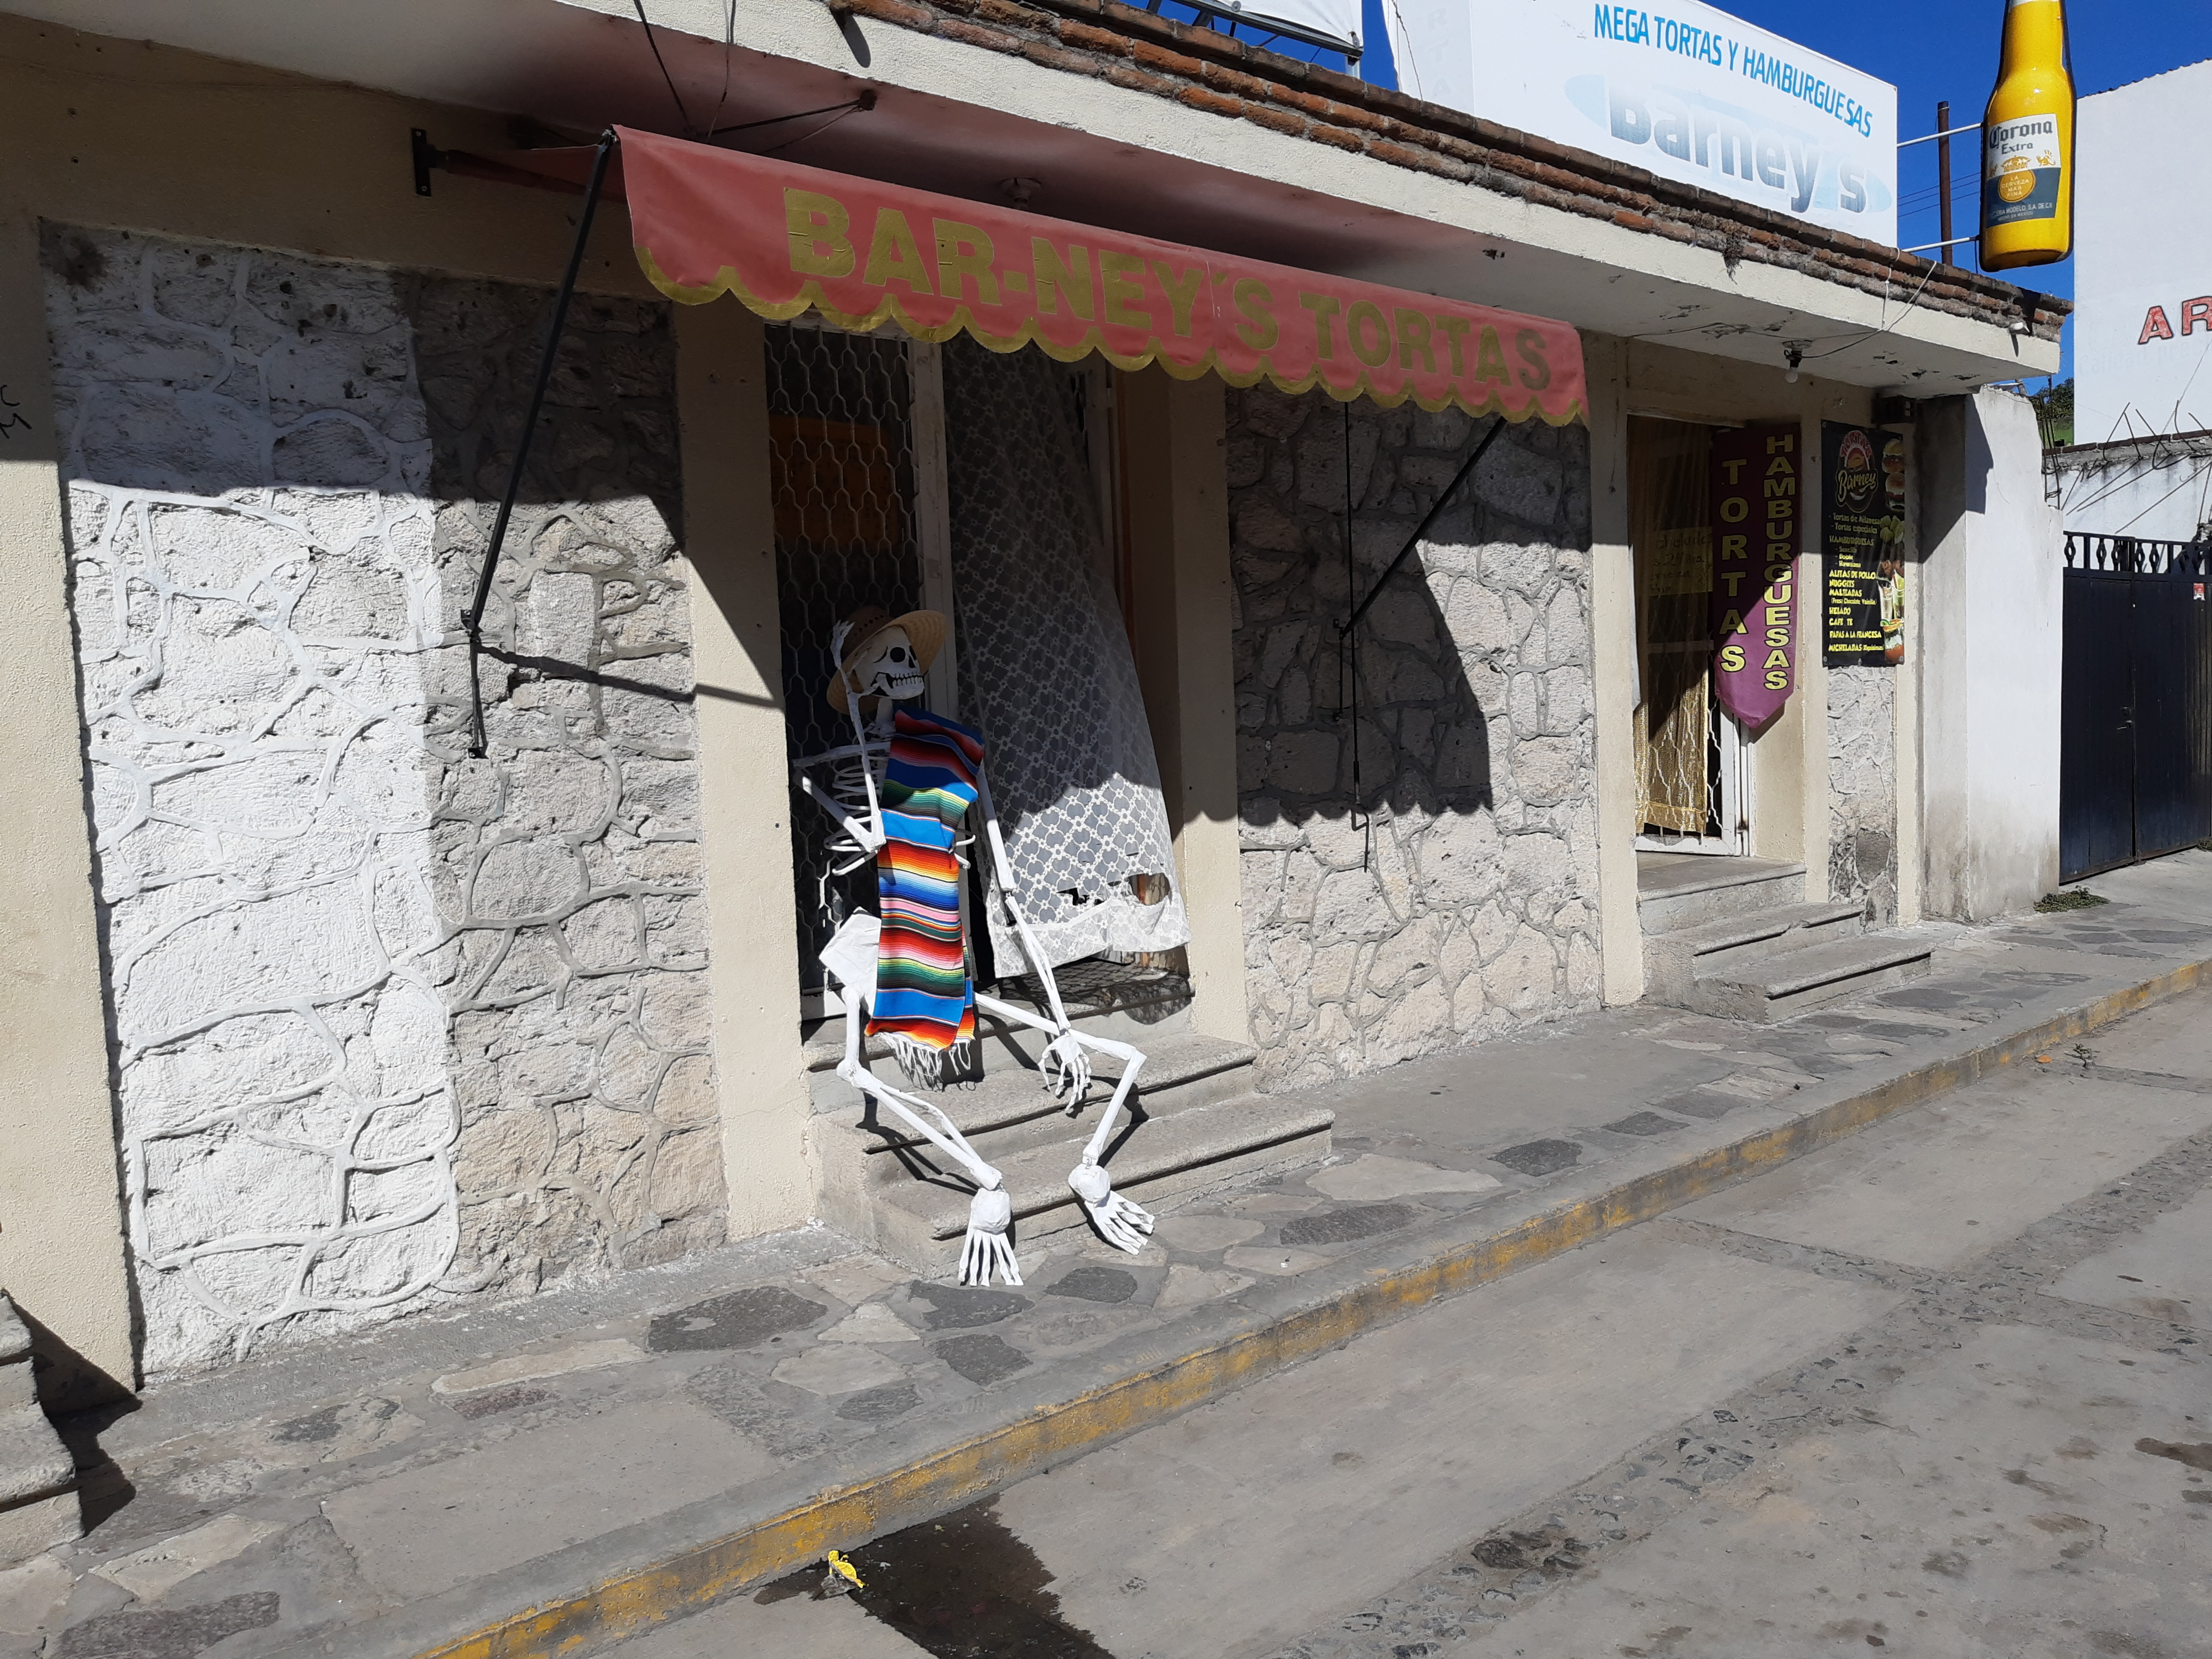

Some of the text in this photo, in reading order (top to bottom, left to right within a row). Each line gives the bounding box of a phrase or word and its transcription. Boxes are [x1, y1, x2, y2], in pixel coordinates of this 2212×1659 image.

[1594, 3, 1873, 138] MEGA TORTAS Y HAMBURGUESAS
[1989, 121, 2053, 149] Corona
[2001, 142, 2033, 155] Extra
[2006, 205, 2026, 213] MODELO
[783, 187, 1552, 391] BAR-NEY'S TORTAS
[1838, 470, 1876, 502] Barney
[1835, 522, 1851, 531] Tortas
[1719, 458, 1749, 672] TORTAS
[1761, 434, 1796, 690] HAMBURGUESAS
[1829, 570, 1850, 578] ALITAS
[1859, 571, 1876, 580] POLLO
[1829, 579, 1855, 587] NUGGETS
[1829, 588, 1862, 597] MALTEADAS
[1829, 607, 1851, 615] HELADO
[1829, 630, 1845, 639] PAPAS
[1828, 644, 1863, 652] MICHELADAS
